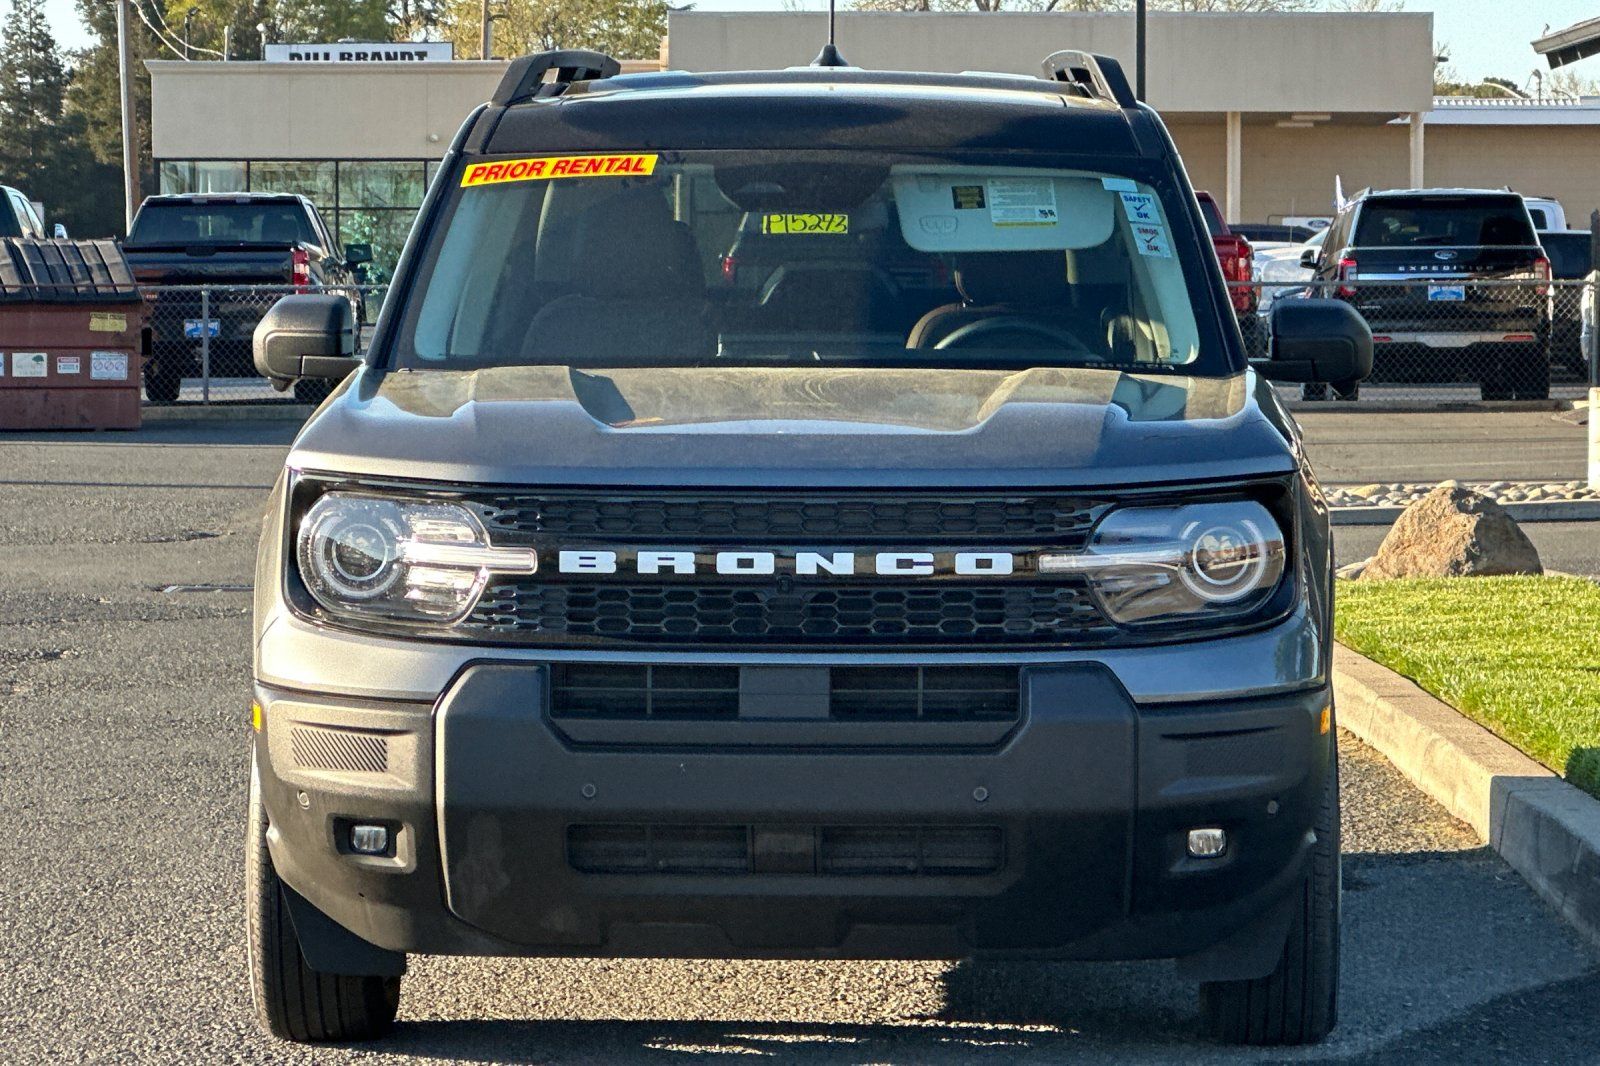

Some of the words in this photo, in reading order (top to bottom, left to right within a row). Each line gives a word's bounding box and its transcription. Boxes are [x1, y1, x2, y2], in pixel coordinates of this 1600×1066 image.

[467, 160, 548, 184] PRIOR
[550, 157, 646, 175] RENTAL
[558, 550, 1014, 576] BRONCO
